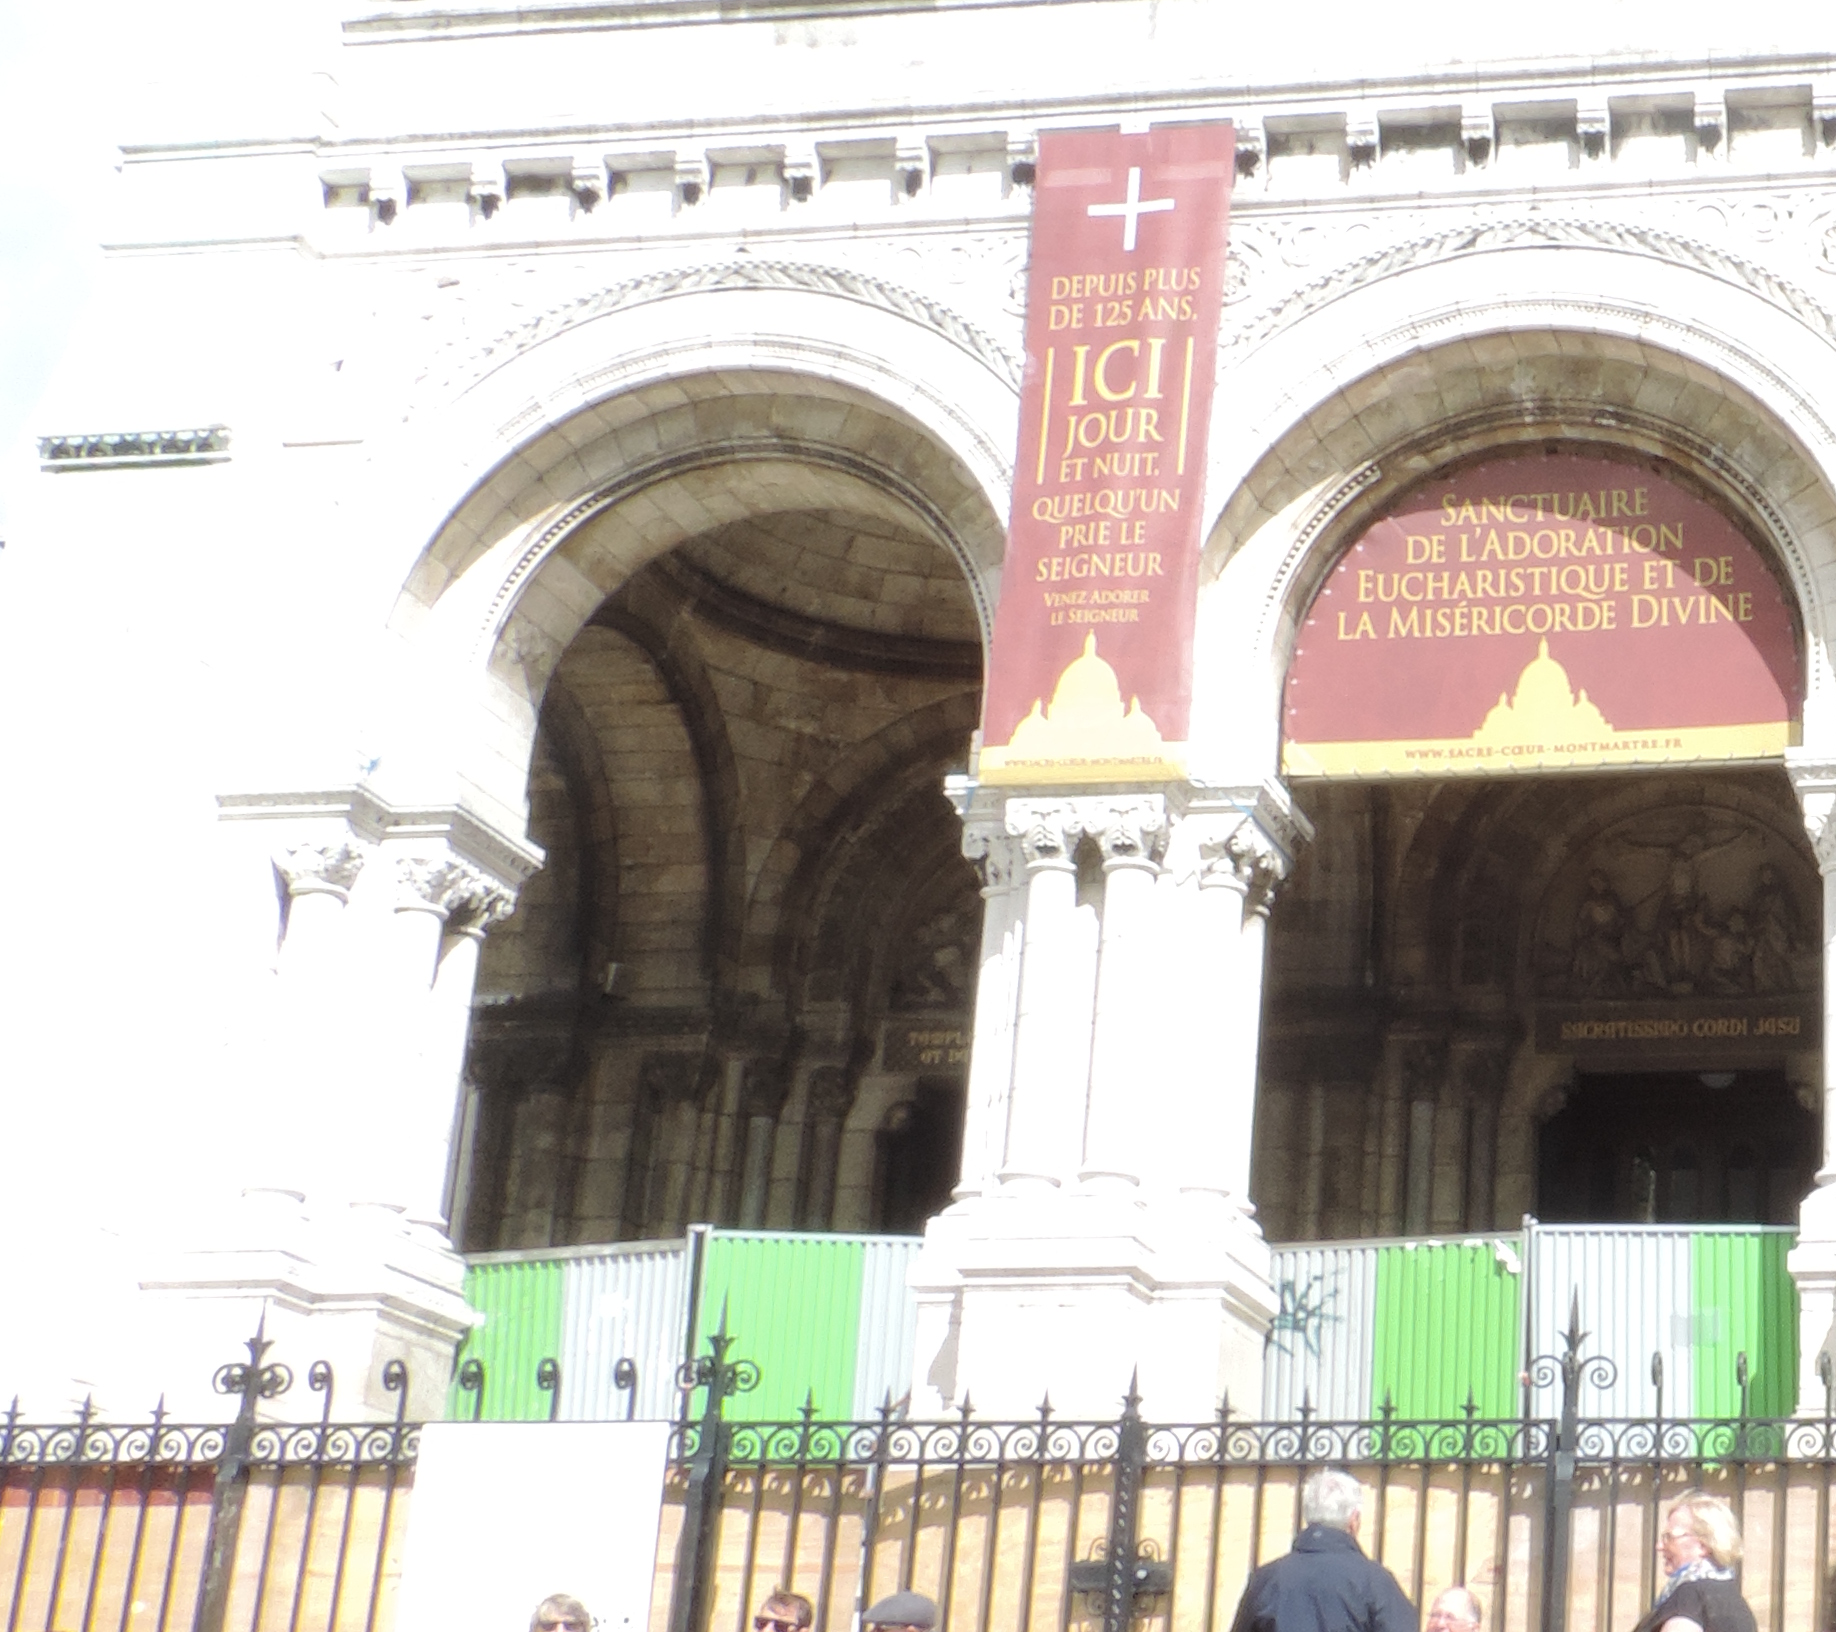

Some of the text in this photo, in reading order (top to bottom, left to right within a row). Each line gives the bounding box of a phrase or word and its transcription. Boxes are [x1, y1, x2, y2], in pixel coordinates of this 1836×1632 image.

[1051, 267, 1201, 300] DEPUIS PLUS
[1049, 303, 1084, 330] DE
[1094, 300, 1133, 327] 125
[1068, 338, 1166, 406] ICI
[1061, 407, 1165, 458] JOUR
[1059, 458, 1088, 483] ET
[1032, 488, 1180, 523] QUELQU'UN
[1441, 488, 1649, 526] SANCTUAIRE
[1059, 520, 1146, 549] PRIE LE
[1406, 523, 1684, 565] DE L'ADORATION
[1035, 552, 1164, 582] SEIGNEUR
[1358, 556, 1734, 603] EUCHARISTIQUE ET DE
[1043, 589, 1149, 607] VENEZ ADORER
[1068, 608, 1139, 623] SEIGNEUR
[1337, 592, 1753, 641] LA MISÉRICORDE DIVINE
[1692, 1018, 1748, 1036] CORDI
